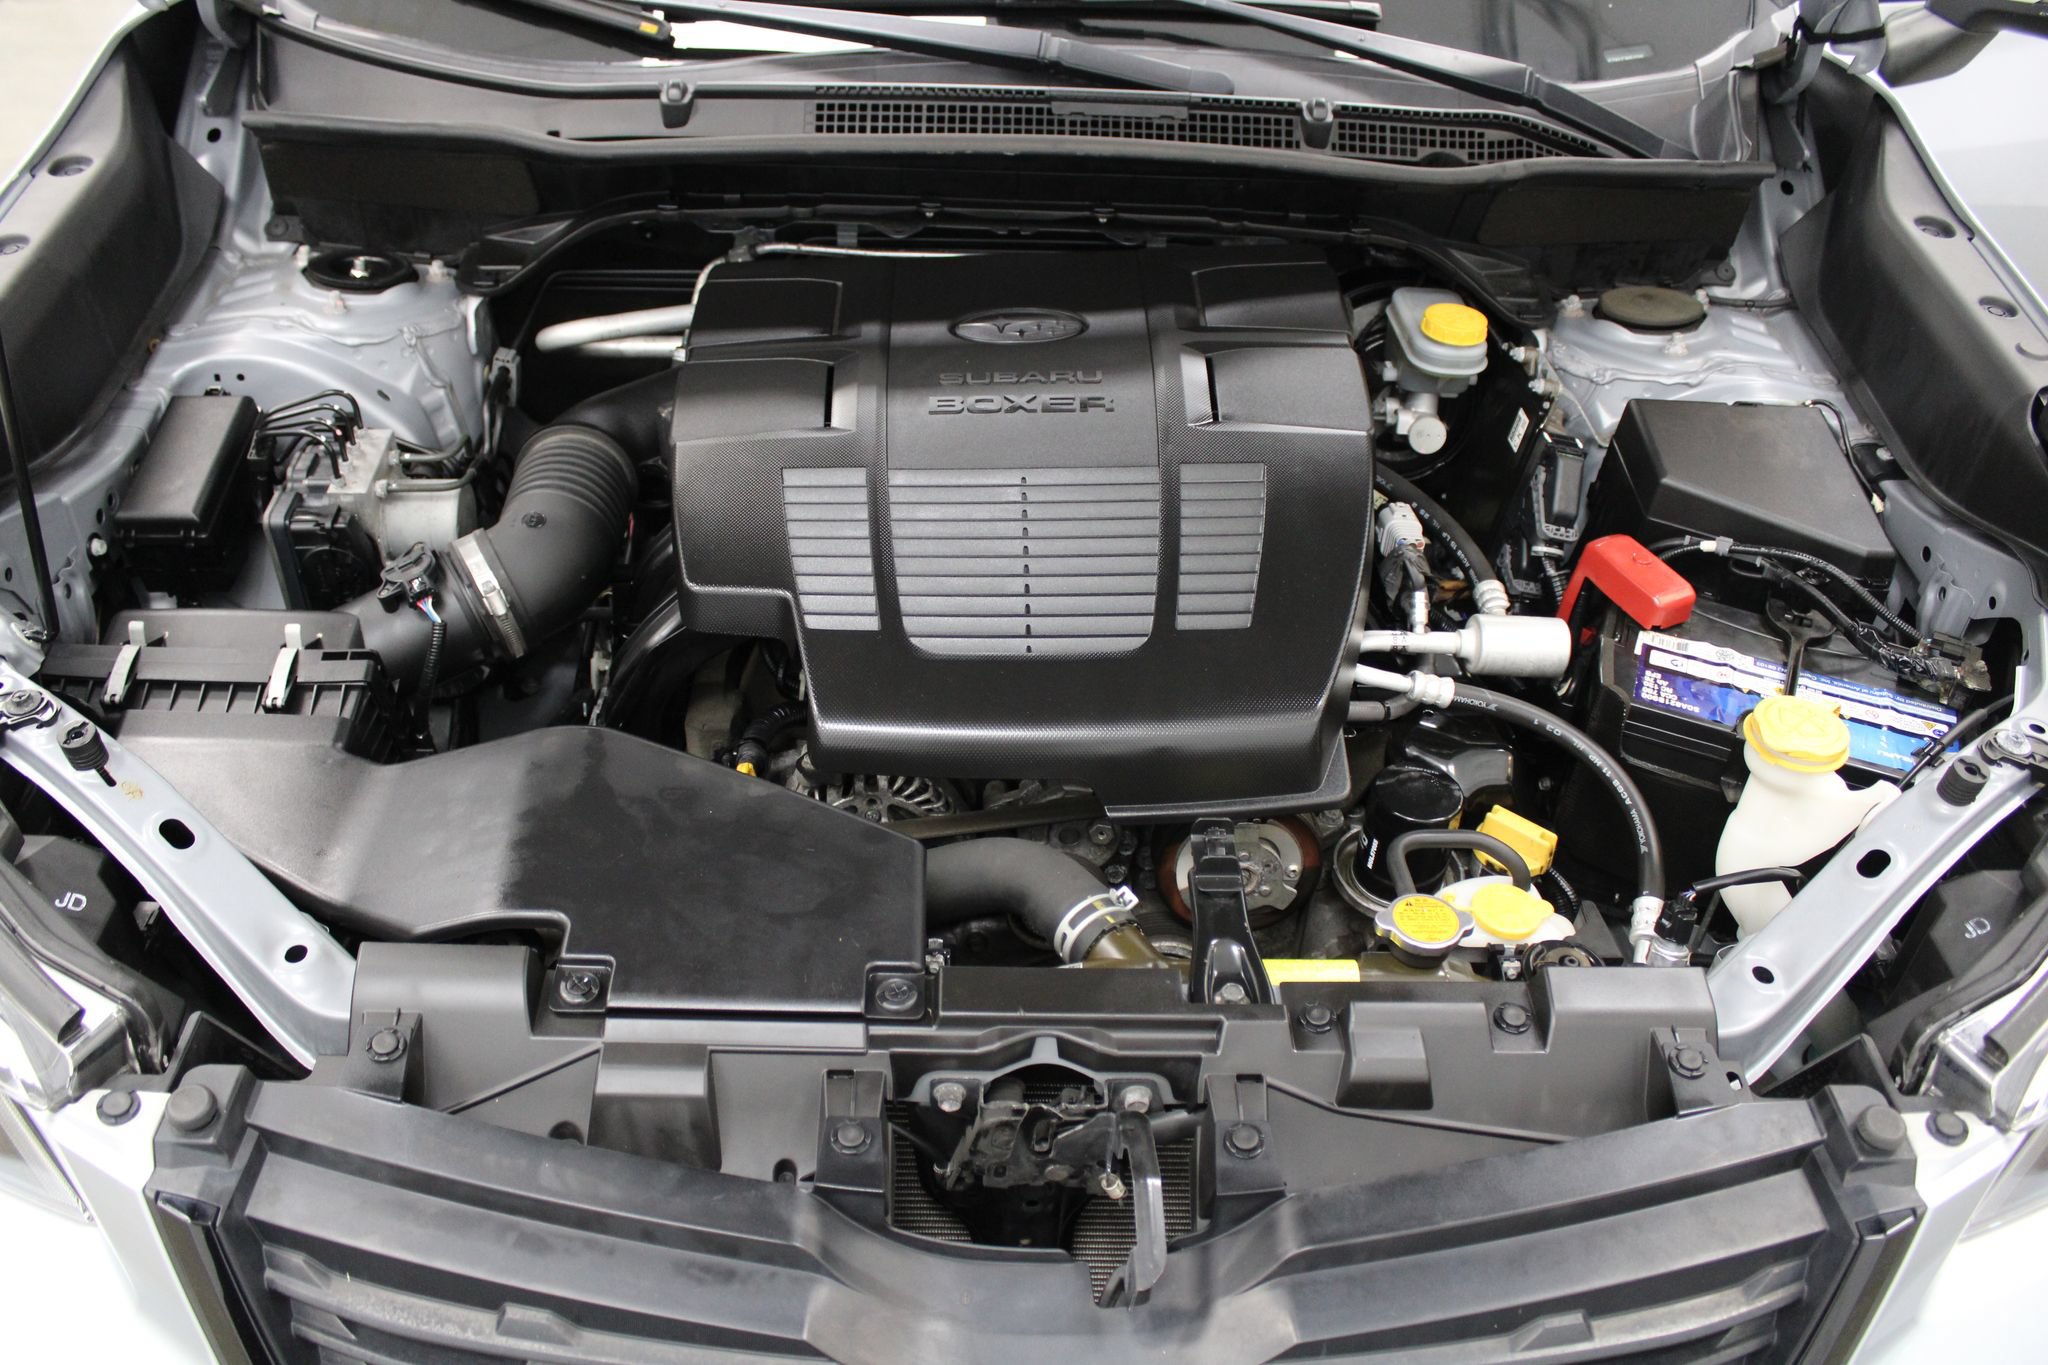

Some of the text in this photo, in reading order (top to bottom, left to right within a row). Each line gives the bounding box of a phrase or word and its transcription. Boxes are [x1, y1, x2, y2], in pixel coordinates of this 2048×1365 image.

[939, 369, 1103, 385] SUBARU
[928, 394, 1115, 416] BOXER
[54, 891, 87, 912] JD
[1964, 917, 1991, 939] JD
